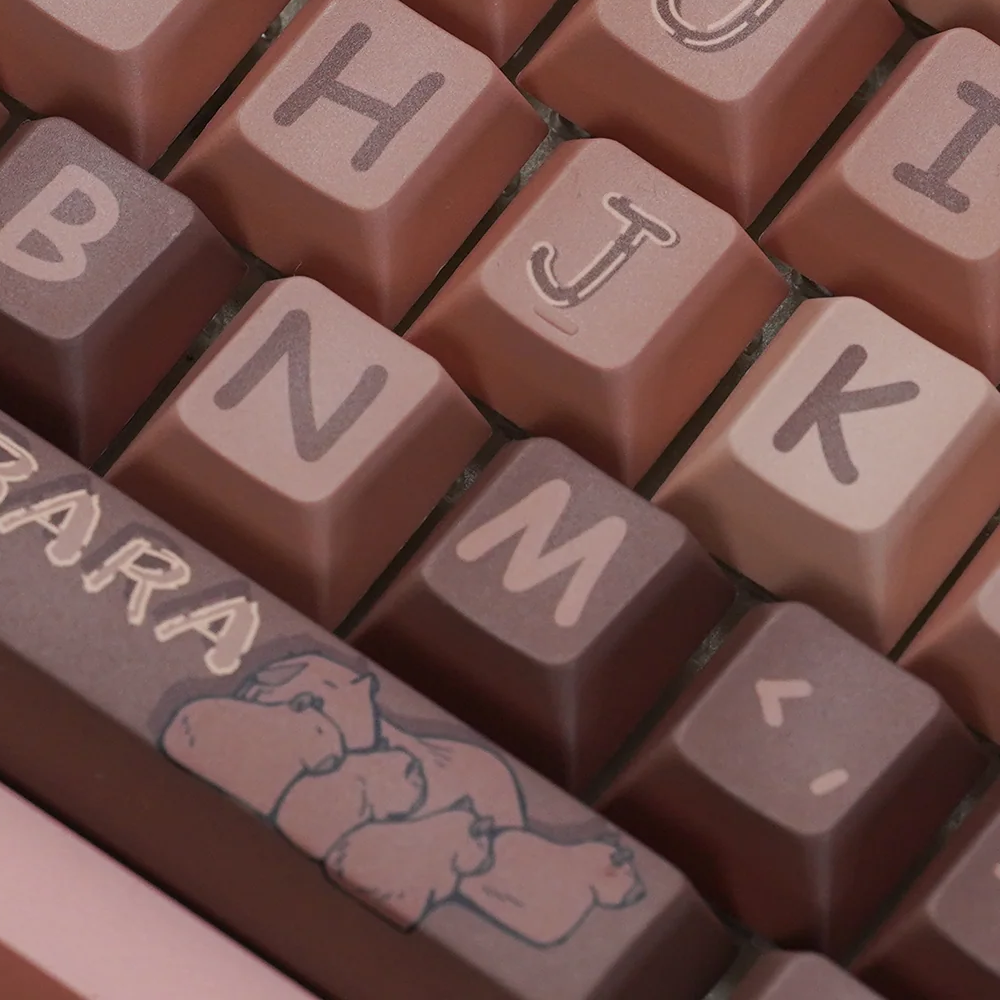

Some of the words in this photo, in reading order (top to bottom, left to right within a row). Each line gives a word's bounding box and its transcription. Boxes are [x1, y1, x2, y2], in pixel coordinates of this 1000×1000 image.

[272, 21, 446, 173] H
[892, 80, 1000, 214] I
[525, 190, 680, 309] J
[213, 308, 389, 464] N
[771, 343, 921, 486] K
[455, 478, 629, 628] M
